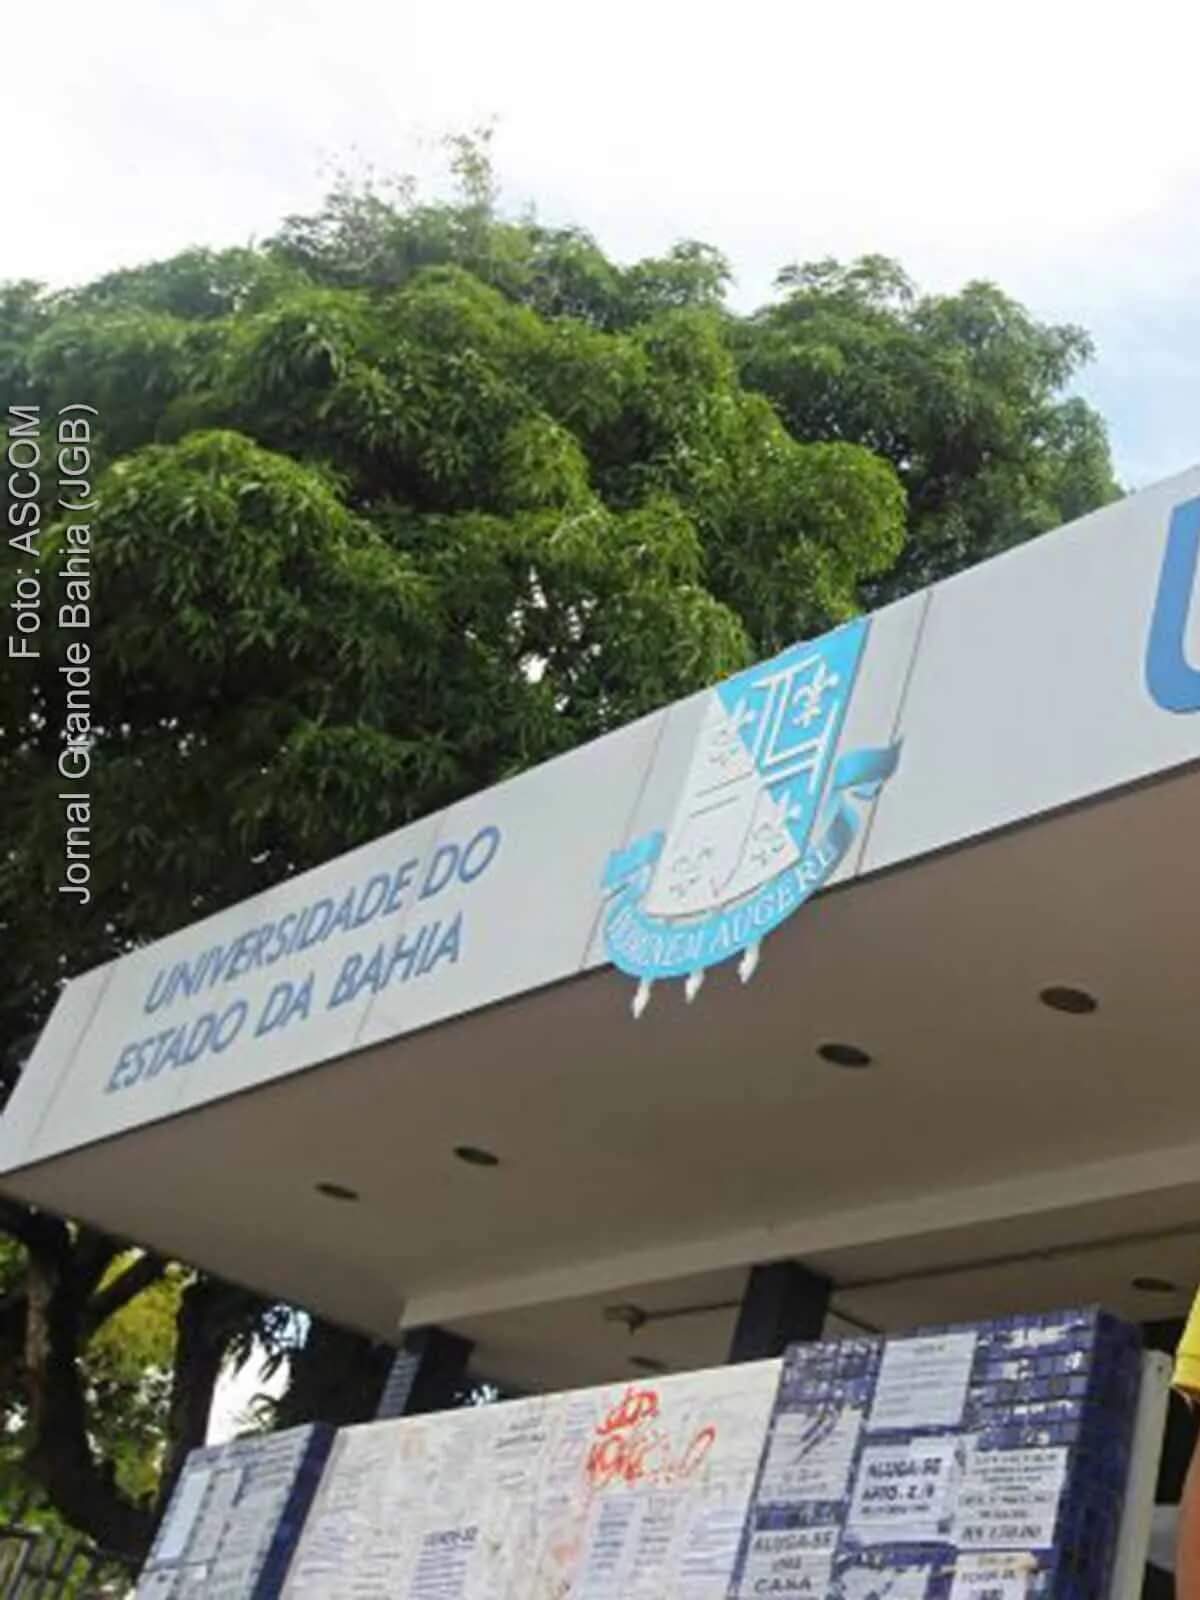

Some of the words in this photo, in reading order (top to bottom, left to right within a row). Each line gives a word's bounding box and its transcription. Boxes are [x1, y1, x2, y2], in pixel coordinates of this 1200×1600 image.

[105, 1000, 248, 1093] ESTADO
[255, 972, 316, 1038] DA
[326, 911, 463, 1010] BAHIA
[143, 858, 420, 1014] UNIVERSIDADE
[418, 826, 500, 898] DO
